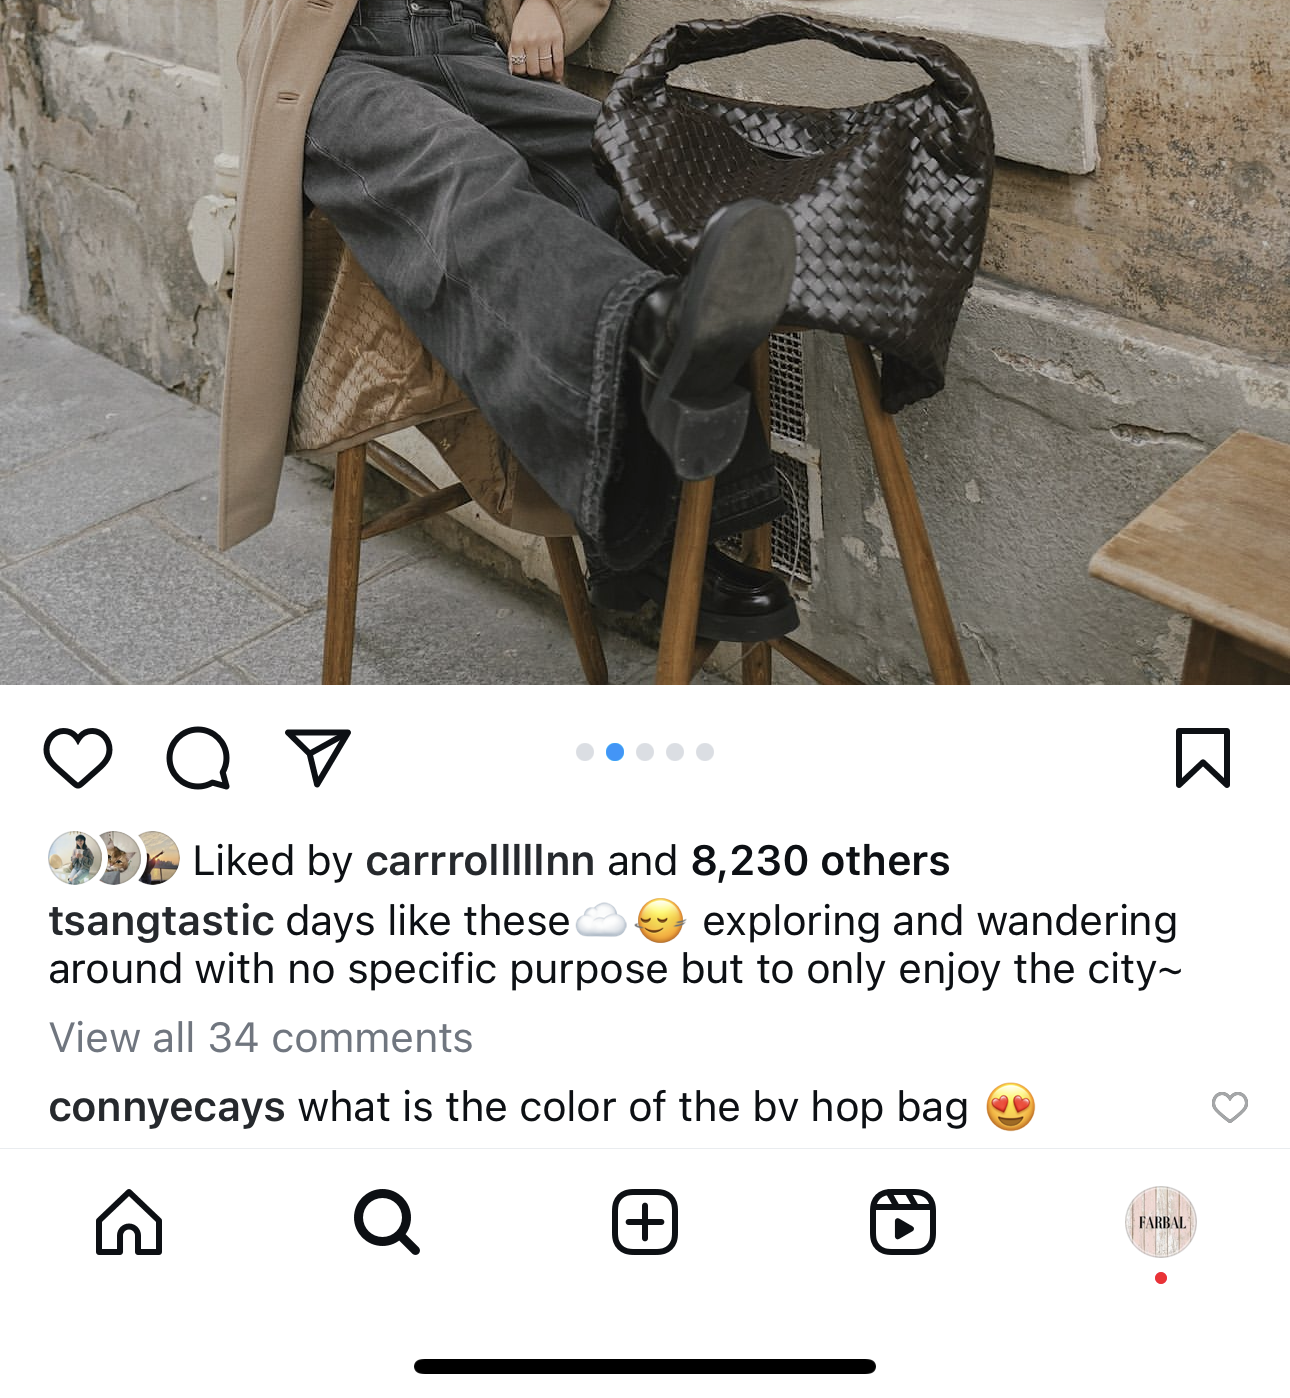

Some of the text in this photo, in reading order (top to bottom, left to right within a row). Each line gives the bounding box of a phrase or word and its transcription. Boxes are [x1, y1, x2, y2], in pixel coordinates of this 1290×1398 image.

[195, 843, 950, 884] Liked by carrrolllllnn and 8,230 others
[48, 902, 1177, 944] tsangtastic days like these exploring and wandering
[49, 951, 1182, 992] around with no specific purpose but to only enjoy the city~
[49, 1020, 473, 1054] View all 34 comments
[49, 1089, 968, 1130] connyecays what is the color of the bv hop bag
[1139, 1215, 1187, 1229] FARBAL
